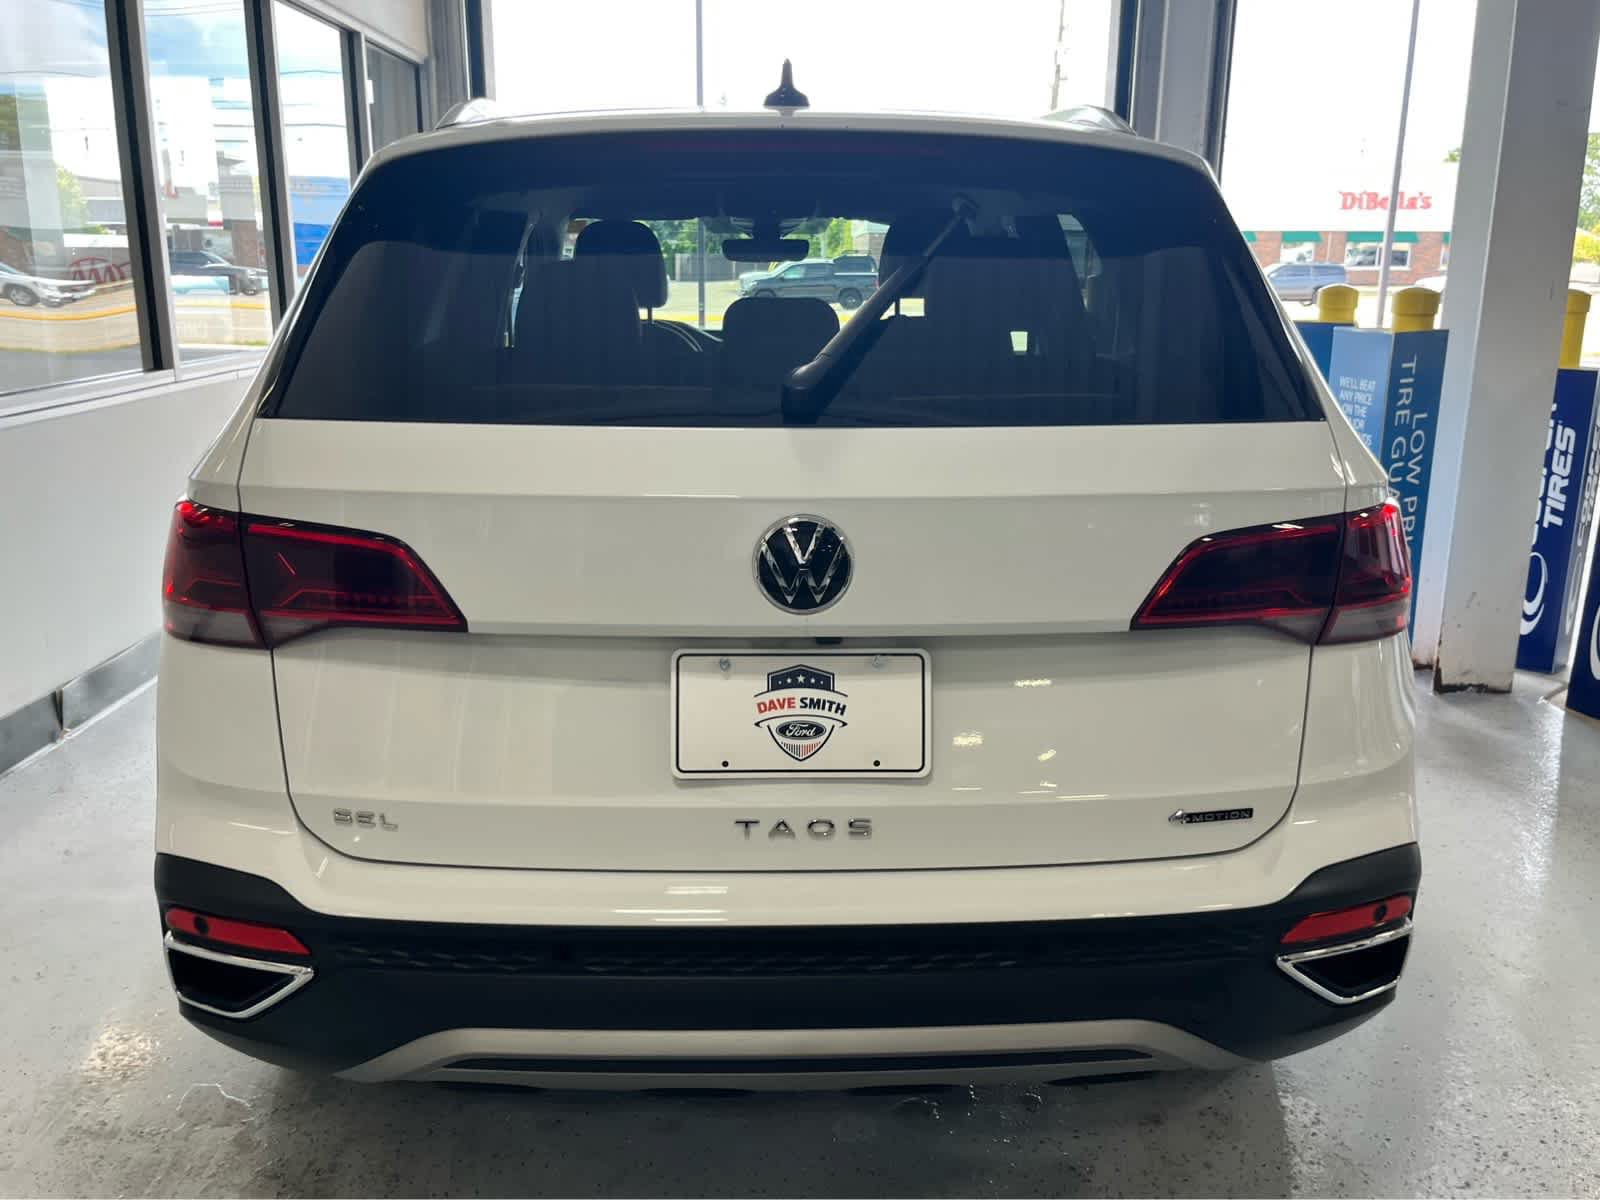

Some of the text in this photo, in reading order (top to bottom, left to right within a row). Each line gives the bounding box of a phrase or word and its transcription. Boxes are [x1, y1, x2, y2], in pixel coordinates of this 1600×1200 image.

[1339, 190, 1432, 210] DiBela's
[1394, 354, 1417, 427] TIRE
[1406, 412, 1429, 485] LOW
[1543, 424, 1576, 528] TIRES
[756, 697, 847, 716] DAVE SMITH
[785, 722, 818, 738] Ford
[333, 808, 399, 832] SEL
[734, 818, 874, 841] TAOS
